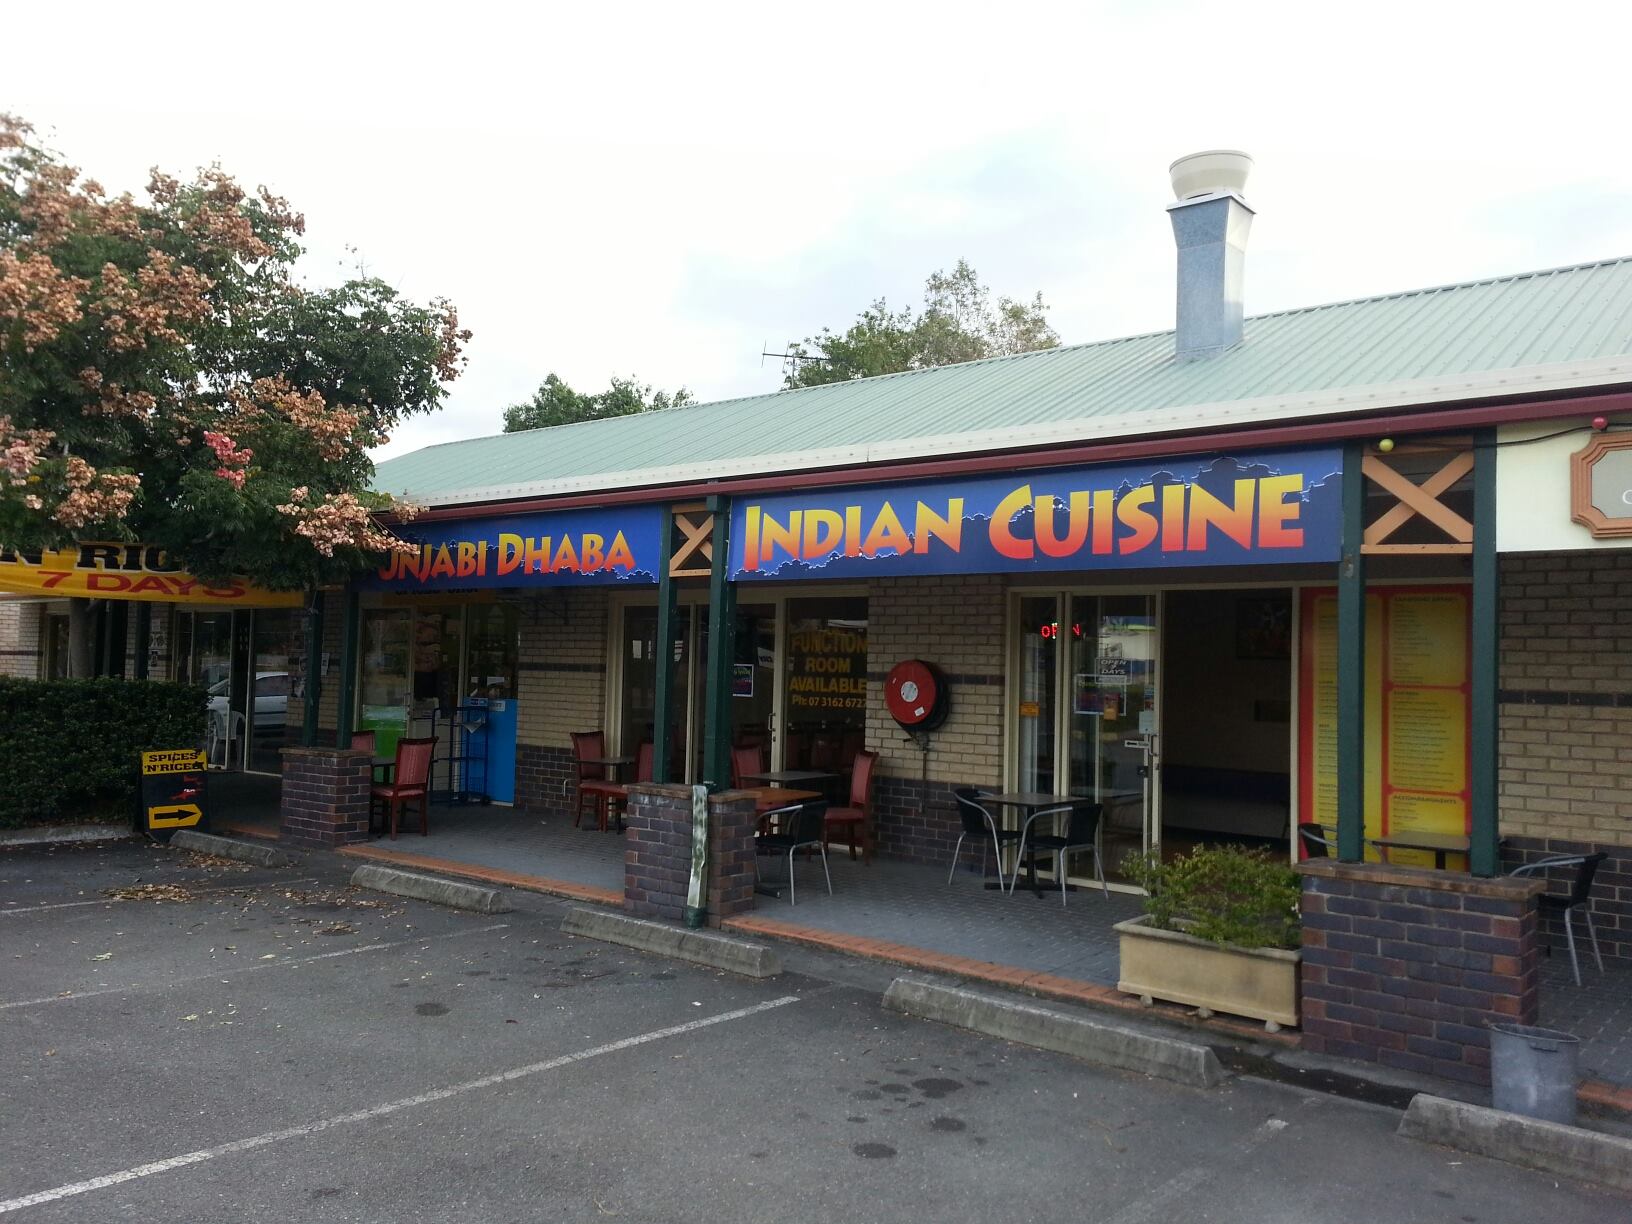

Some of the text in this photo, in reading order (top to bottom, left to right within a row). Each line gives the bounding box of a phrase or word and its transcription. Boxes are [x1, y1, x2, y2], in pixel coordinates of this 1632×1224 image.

[743, 473, 1304, 572] INDIAN CUISINE
[377, 529, 637, 583] UNJABI DHABA
[37, 570, 246, 598] 7 DAYS
[1041, 622, 1082, 639] OPN
[791, 631, 868, 654] FUNCTION
[804, 657, 851, 673] ROOM
[789, 676, 867, 694] AVAILABLE
[808, 696, 820, 706] 07
